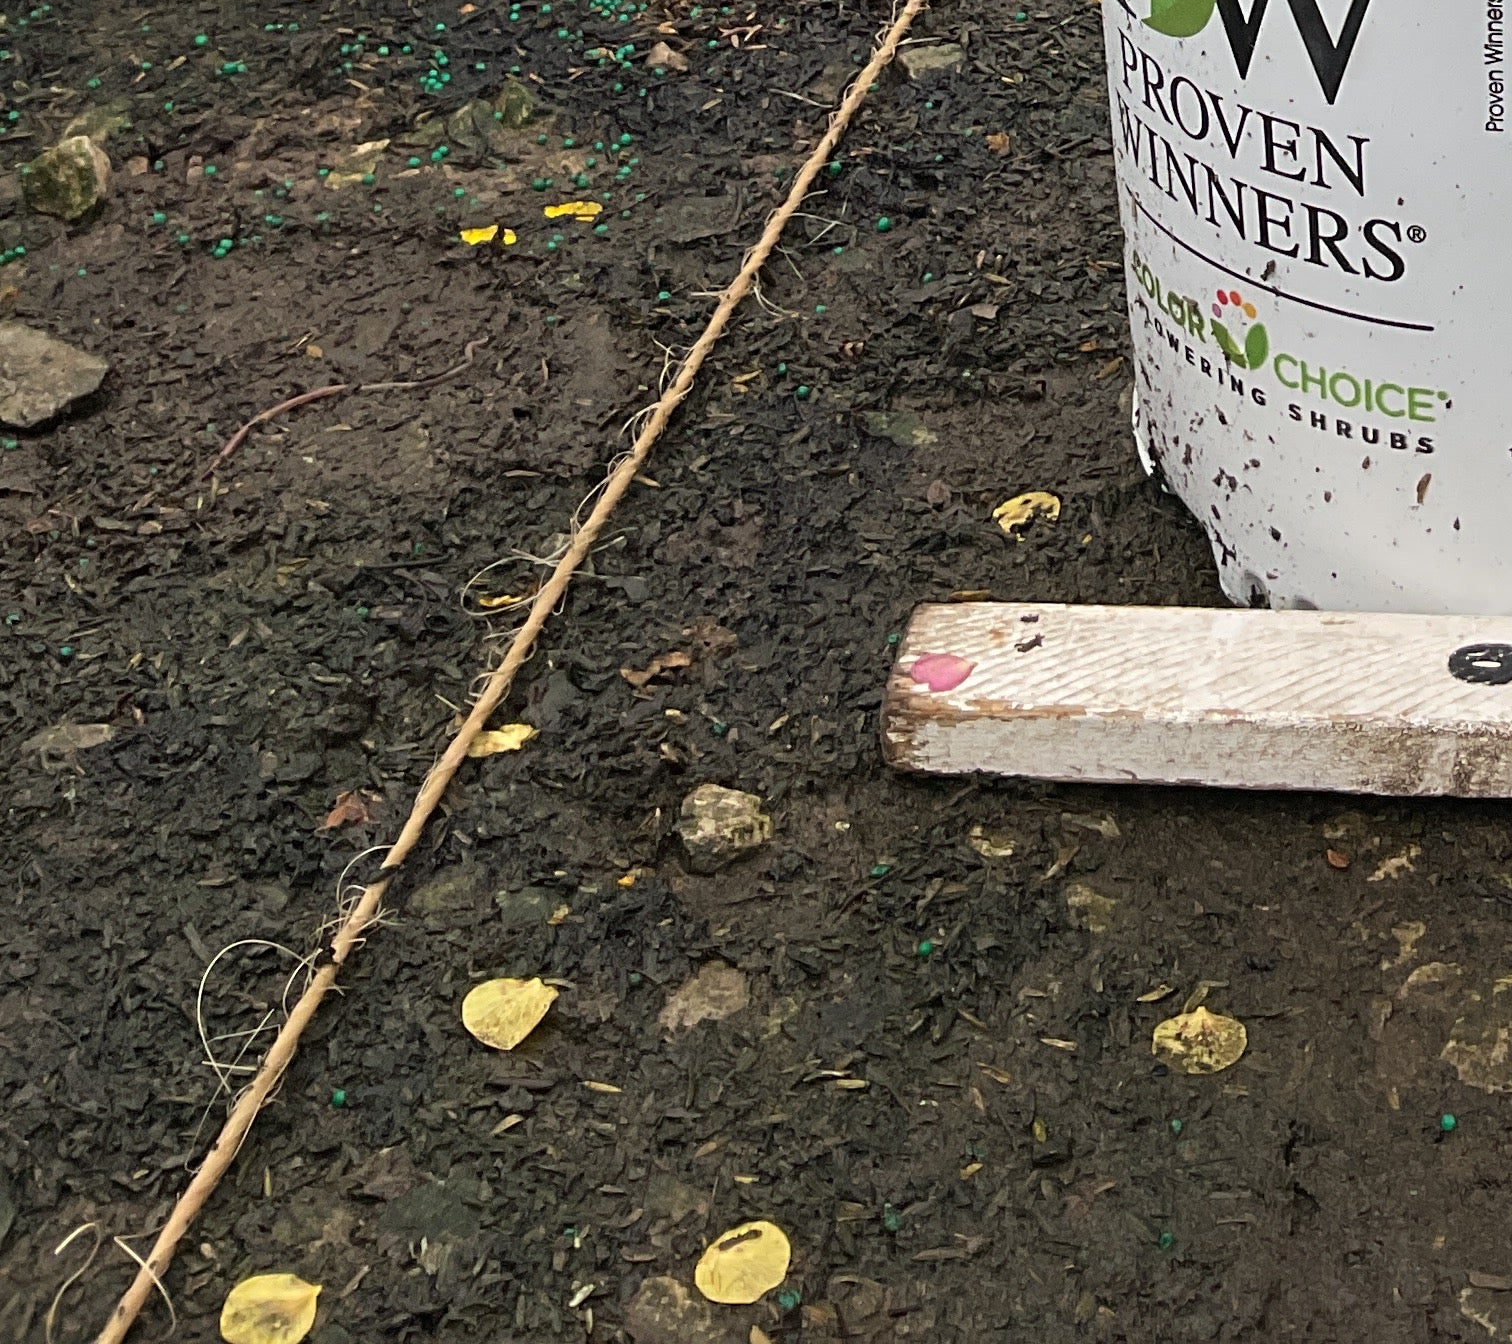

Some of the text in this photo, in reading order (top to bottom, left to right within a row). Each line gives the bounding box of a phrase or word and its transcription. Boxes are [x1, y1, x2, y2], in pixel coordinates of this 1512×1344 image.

[1118, 28, 1371, 197] PROVEN
[1485, 69, 1504, 132] Proven
[1130, 248, 1208, 345] COLOR
[1134, 295, 1436, 454] OWERING SHRUBS
